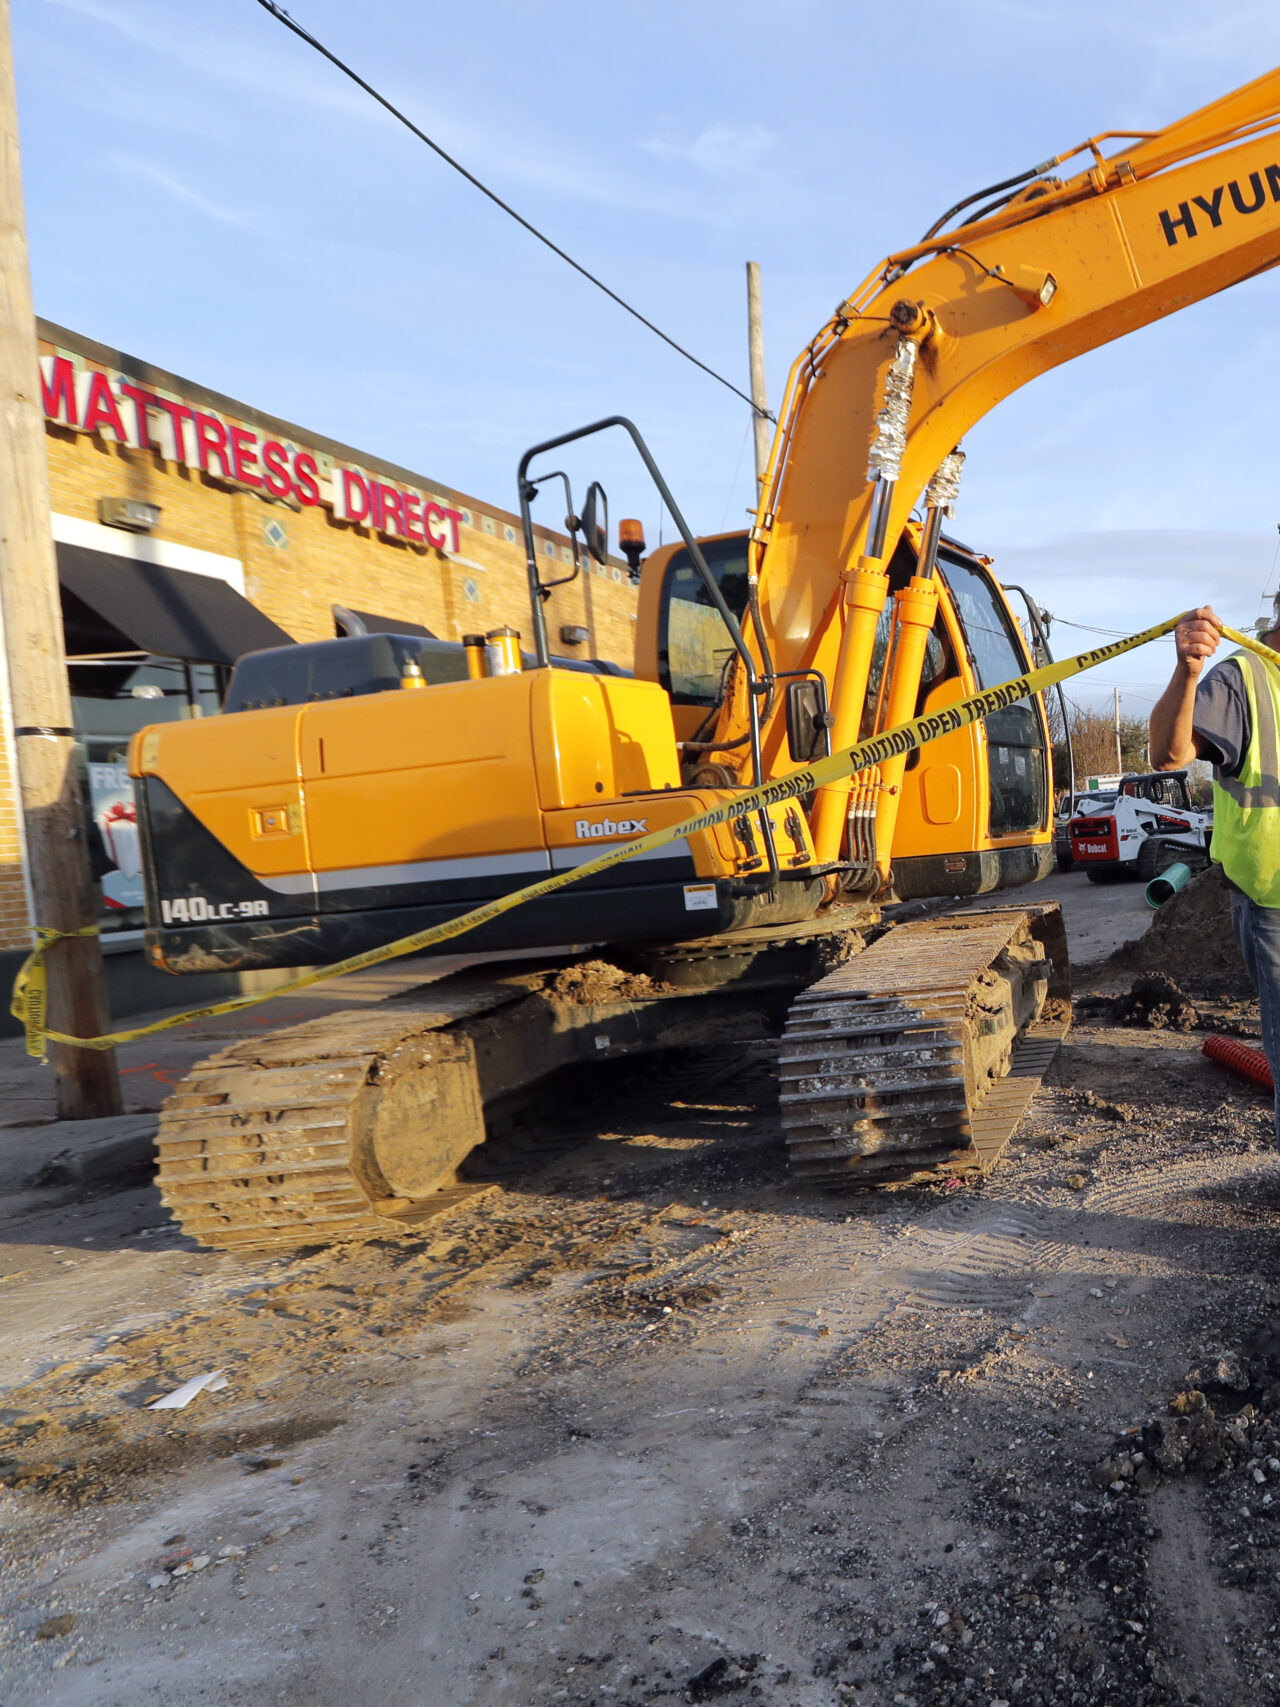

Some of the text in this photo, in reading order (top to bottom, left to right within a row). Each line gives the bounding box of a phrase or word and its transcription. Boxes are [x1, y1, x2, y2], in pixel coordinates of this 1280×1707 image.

[39, 355, 463, 553] MATTRESS DIRECT
[849, 678, 1031, 771] CAUTION OPEN TRENCH
[762, 772, 815, 806] TRENCH
[575, 818, 648, 839] Robex
[1087, 843, 1108, 854] Bobcat
